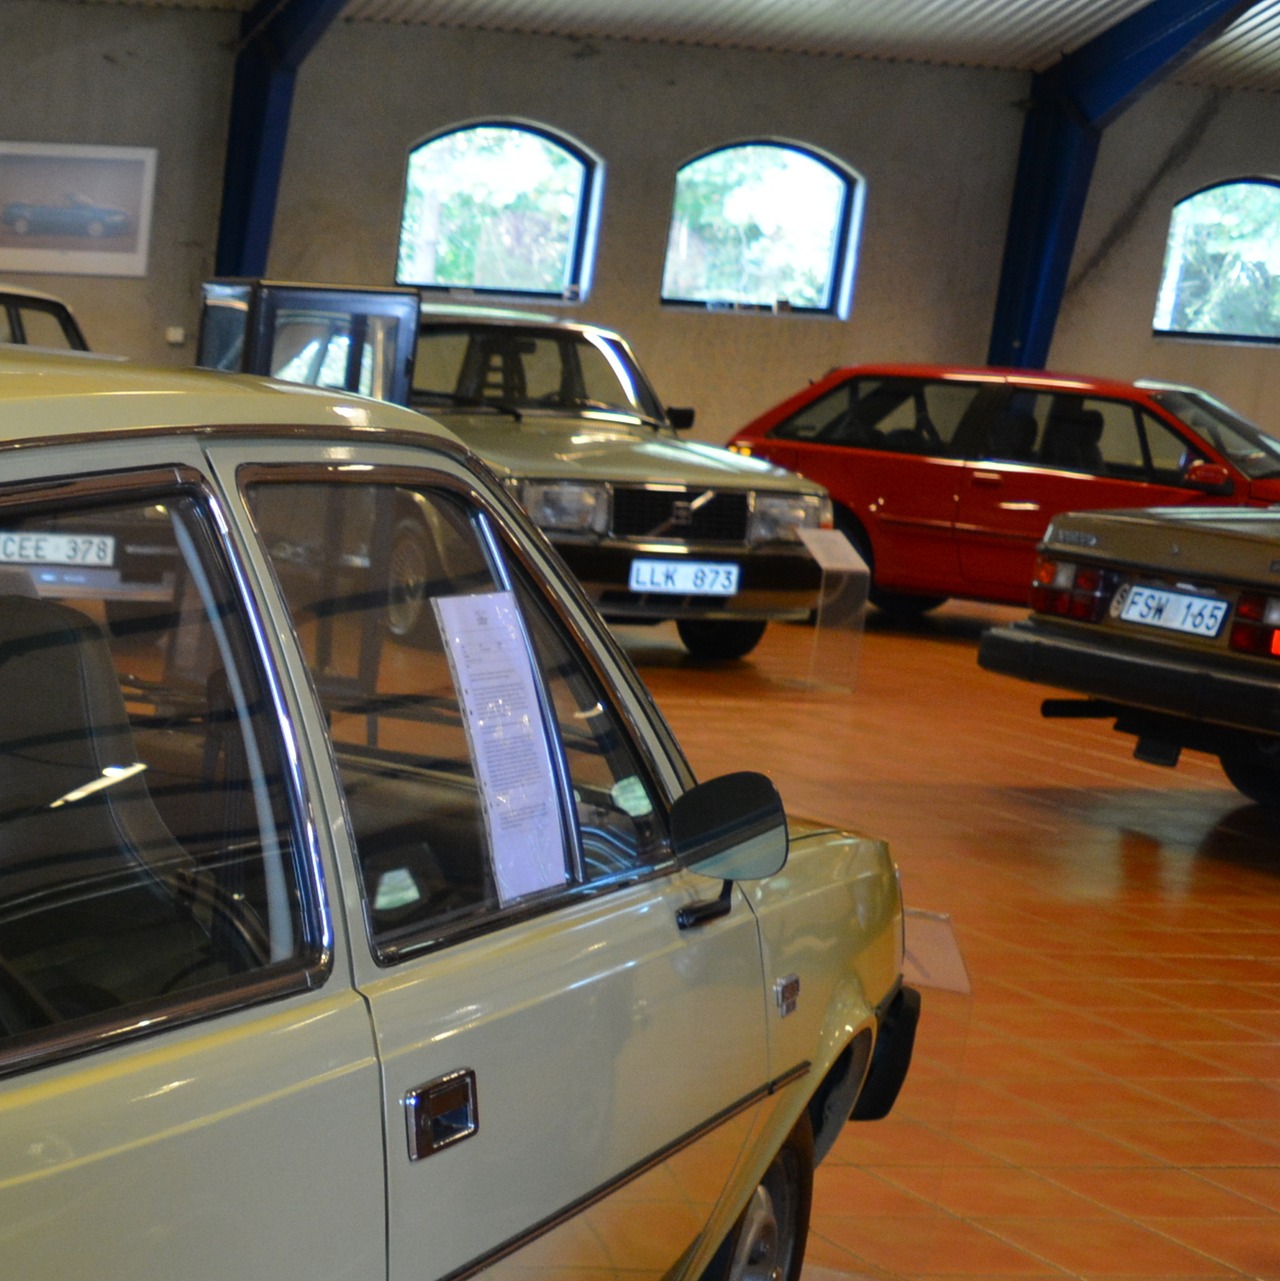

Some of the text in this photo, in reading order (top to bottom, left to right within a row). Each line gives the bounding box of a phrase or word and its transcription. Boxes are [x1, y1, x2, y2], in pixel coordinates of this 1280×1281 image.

[2, 536, 108, 561] CEE 378
[634, 565, 734, 590] LLK 873
[1126, 591, 1223, 631] FSW 165
